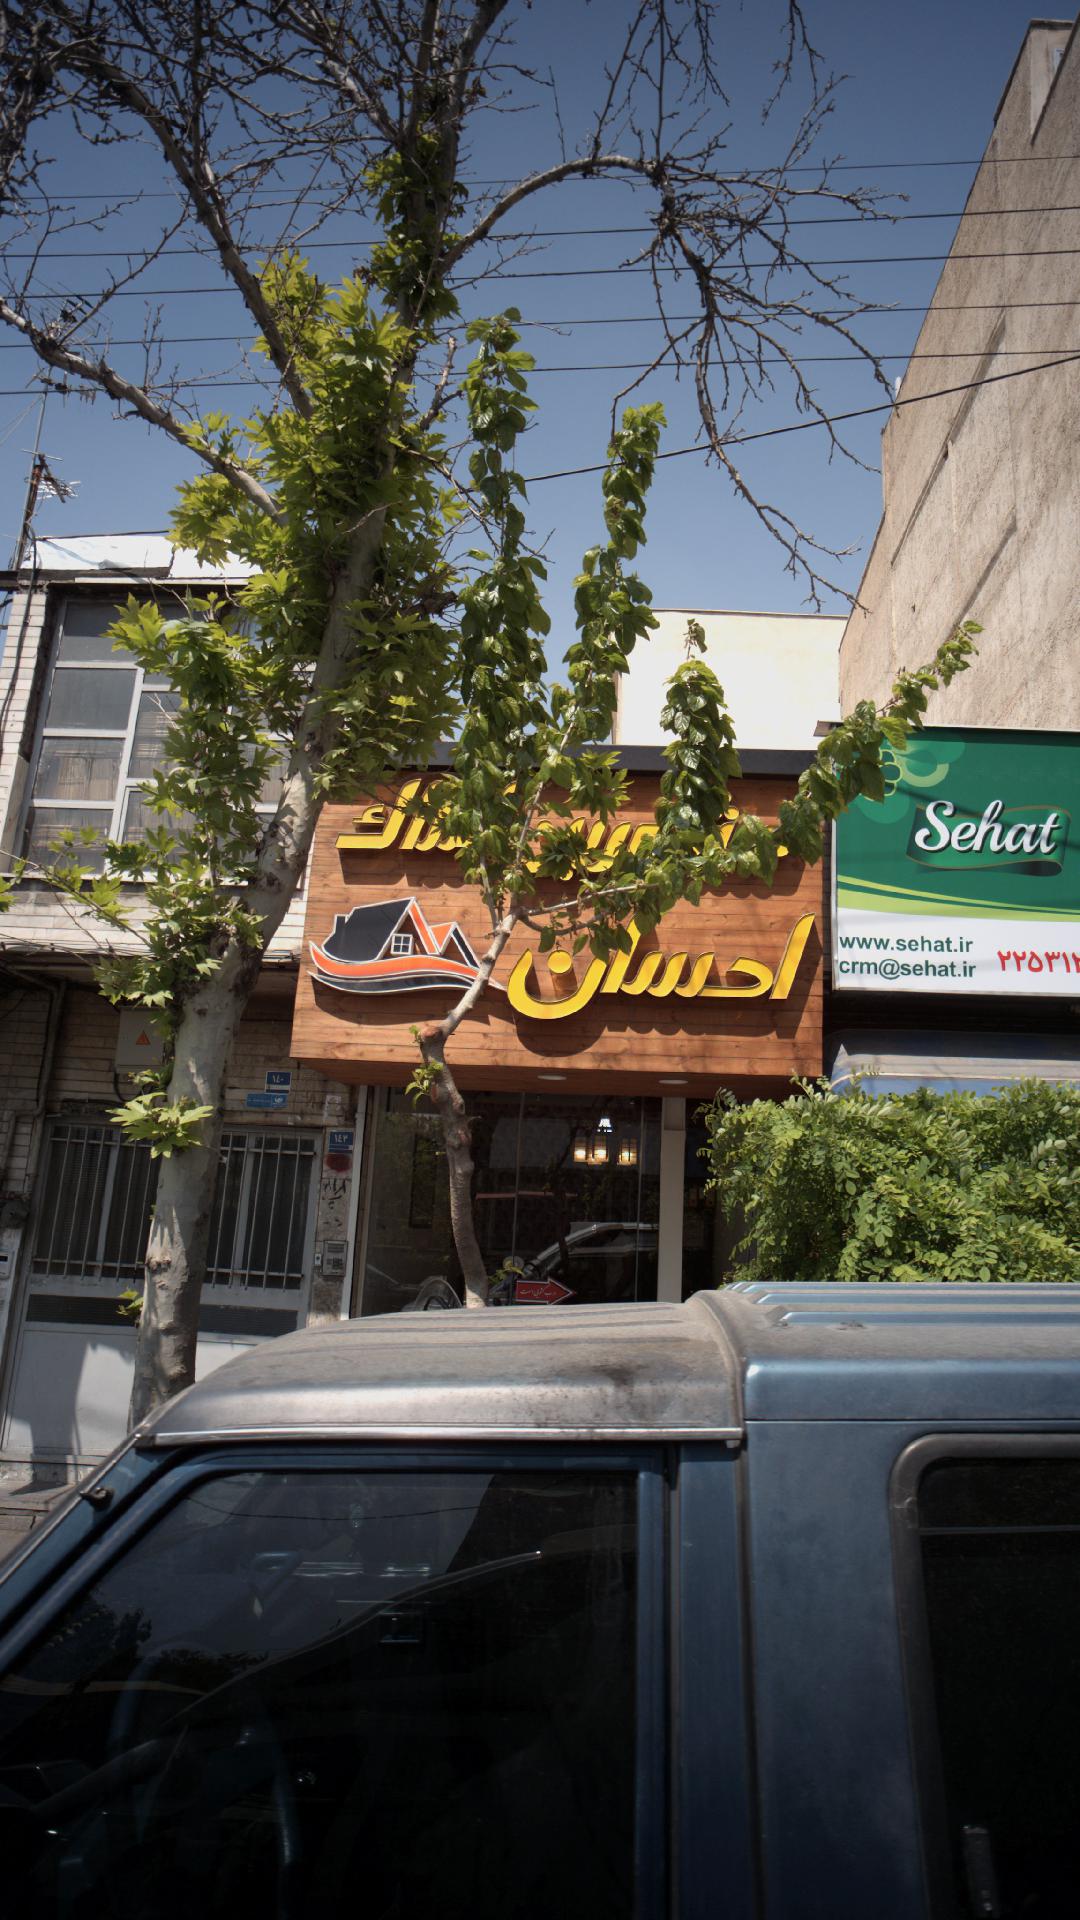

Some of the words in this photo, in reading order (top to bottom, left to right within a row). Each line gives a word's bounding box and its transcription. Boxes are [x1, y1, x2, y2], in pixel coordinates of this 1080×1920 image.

[914, 800, 1060, 853] Sehat
[839, 936, 974, 953] www.sehat.ir
[507, 912, 816, 1019] احسان
[839, 958, 977, 980] crm@sehat.ir
